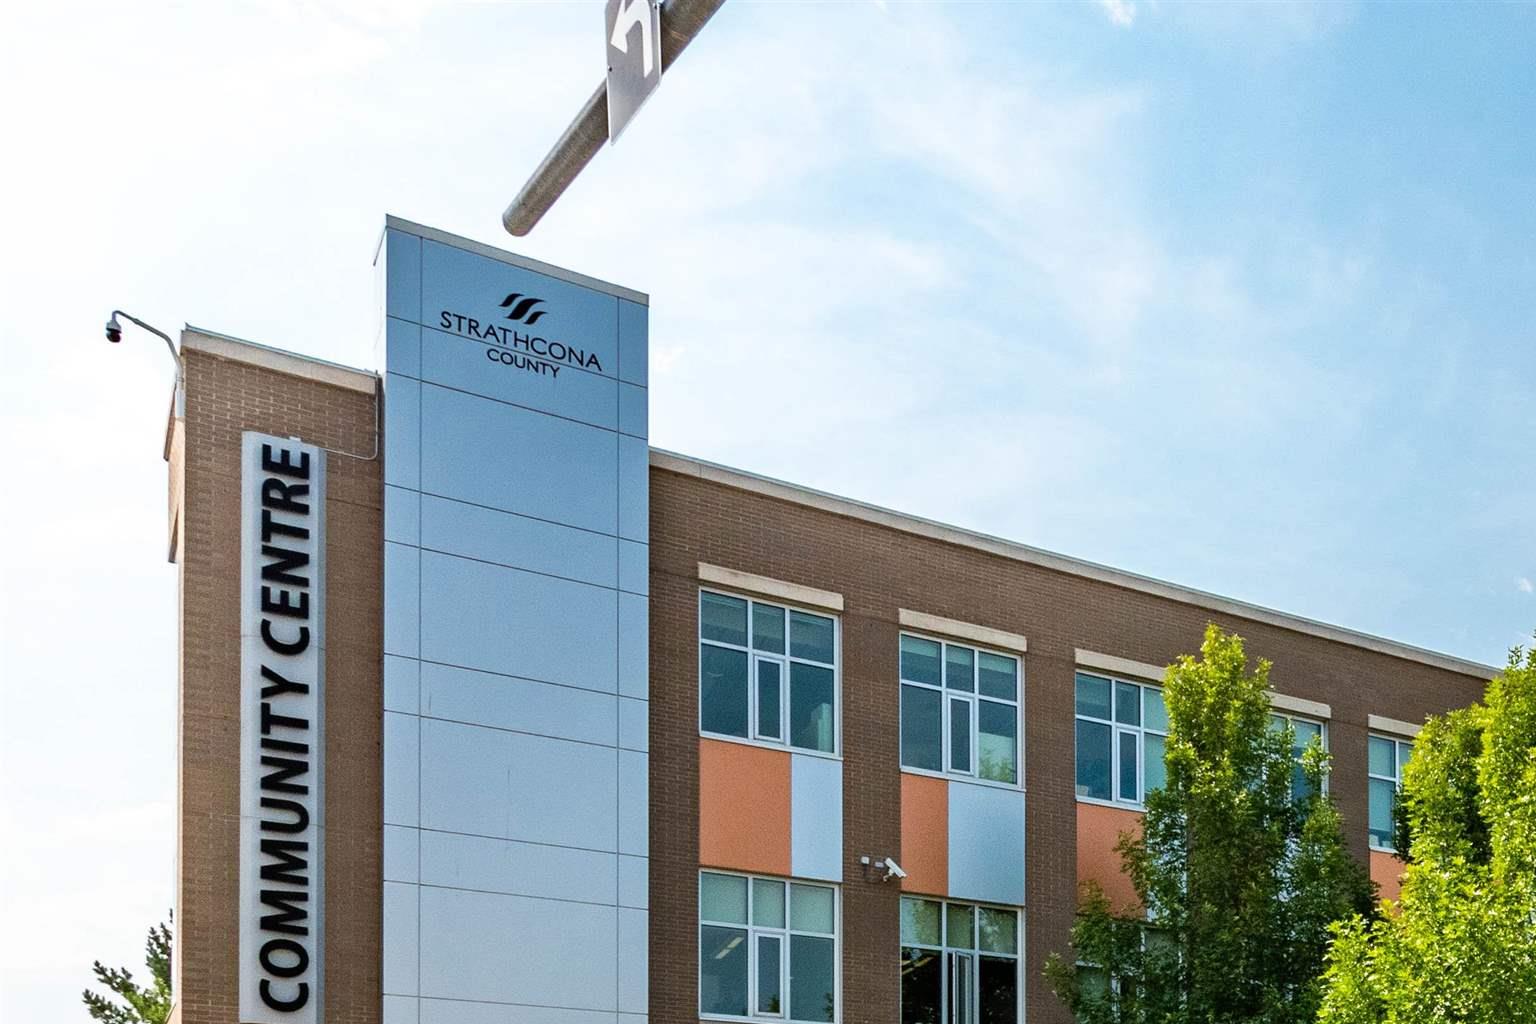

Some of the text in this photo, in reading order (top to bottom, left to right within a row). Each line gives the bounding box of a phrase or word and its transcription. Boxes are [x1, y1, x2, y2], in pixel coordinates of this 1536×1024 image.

[440, 311, 602, 371] STRATHCONA
[487, 349, 560, 378] COUNTY
[259, 443, 310, 1014] COMMUNITY CENTRE
